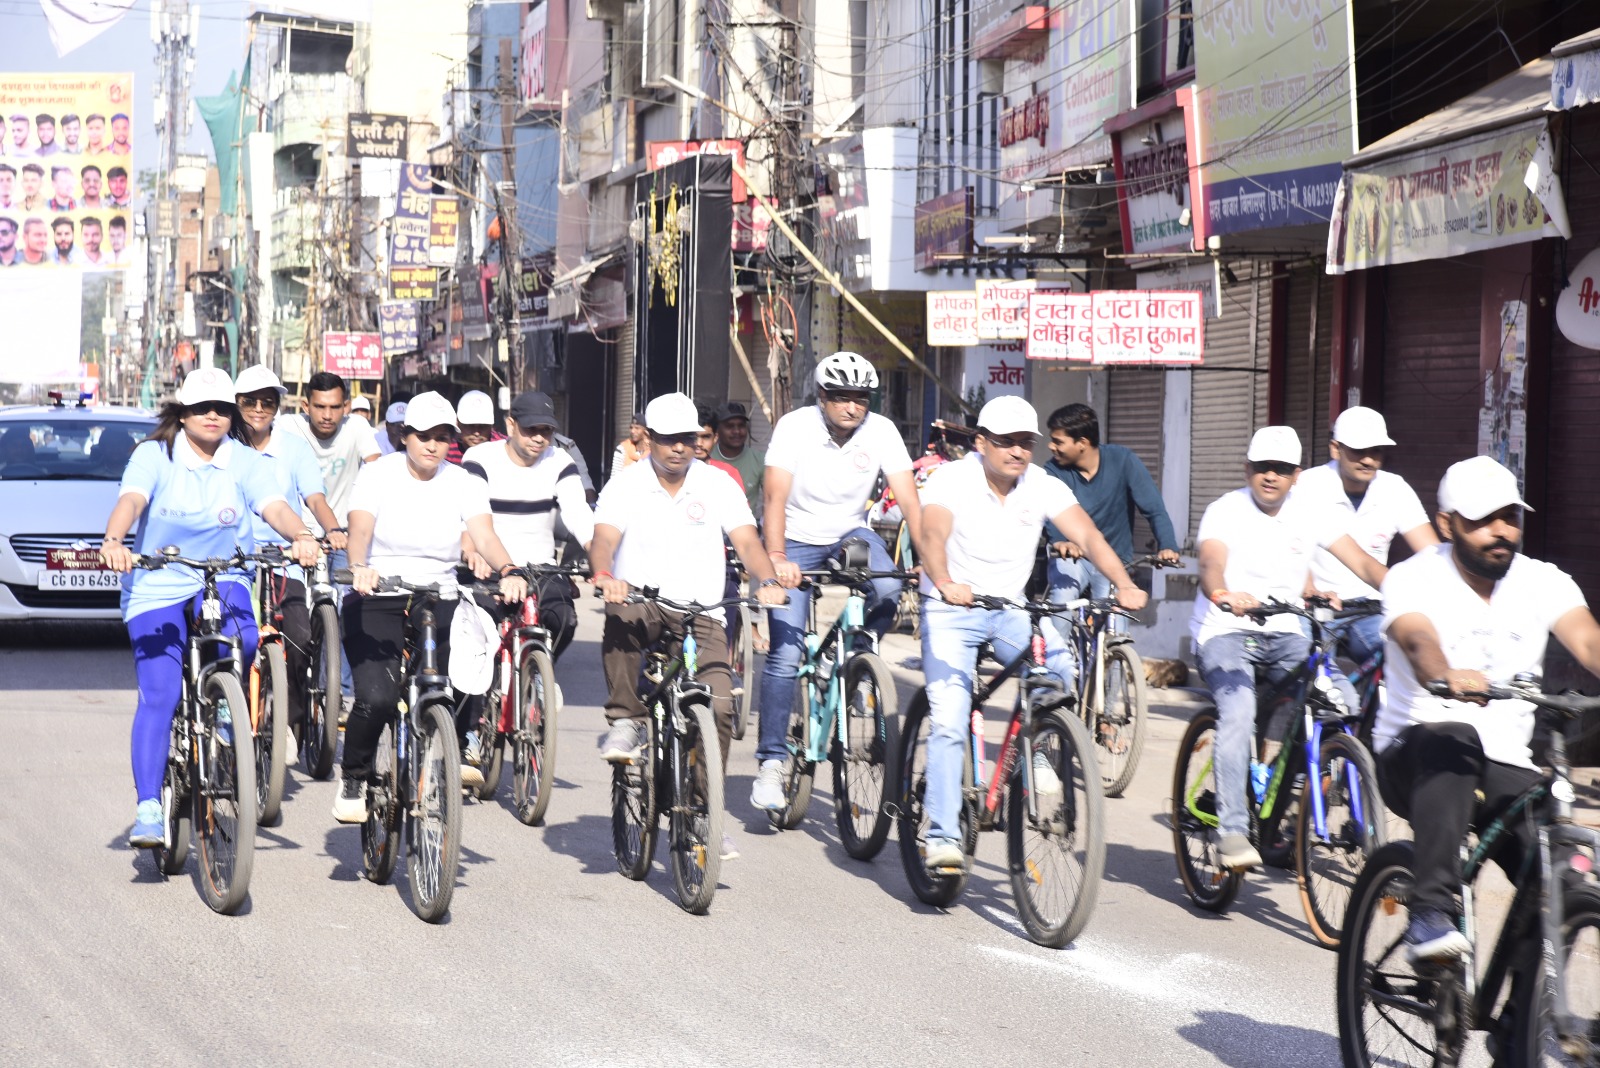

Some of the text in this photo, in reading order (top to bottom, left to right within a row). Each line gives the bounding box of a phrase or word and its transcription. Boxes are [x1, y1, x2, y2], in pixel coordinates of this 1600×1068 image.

[1065, 65, 1115, 110] Collection
[1408, 157, 1449, 201] बालाजी
[981, 303, 1018, 324] लोहा
[1035, 303, 1077, 320] टाटा
[1096, 299, 1140, 319] टाटा
[1145, 299, 1196, 319] वाला
[933, 313, 967, 333] लोहा
[1033, 320, 1076, 345] लोहा
[1097, 321, 1144, 349] लोहा
[1146, 326, 1197, 353] दुकान
[988, 359, 1025, 386] ज्वेल
[50, 549, 76, 563] पुलिस
[51, 574, 118, 587] CG 03 6493
